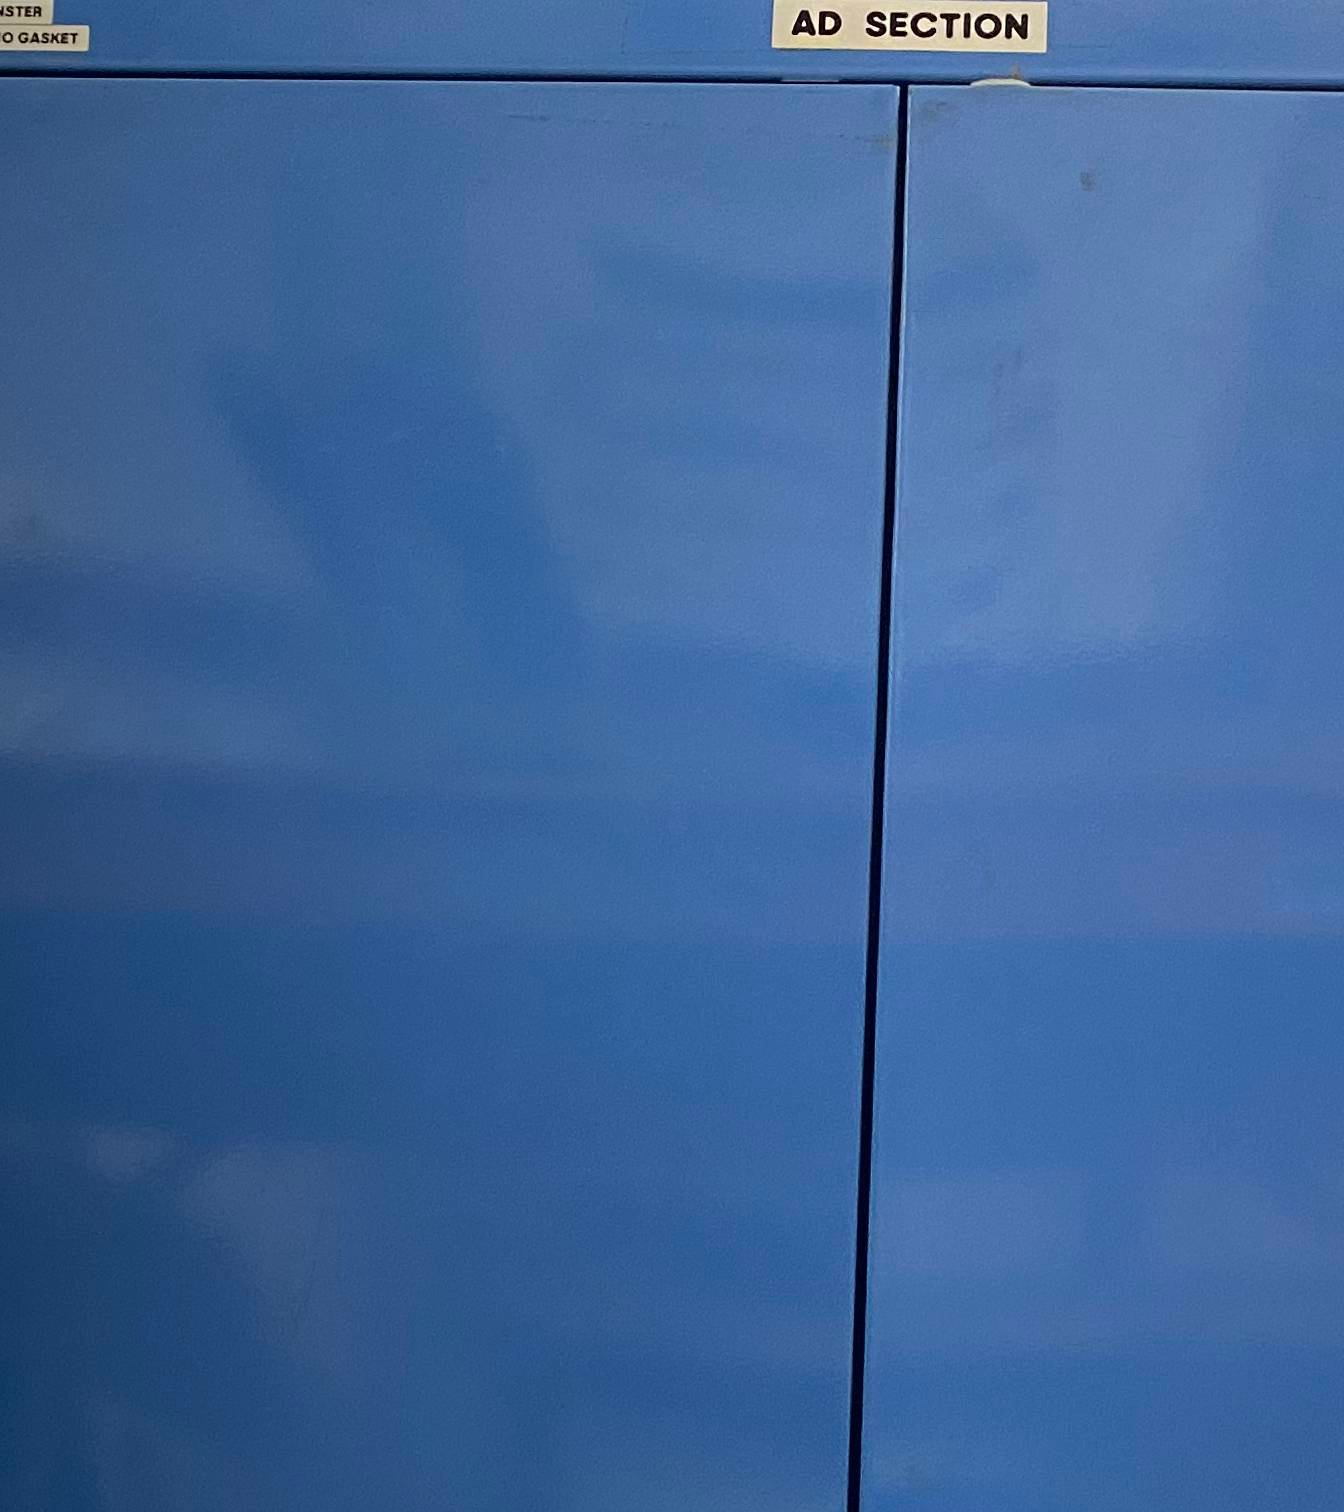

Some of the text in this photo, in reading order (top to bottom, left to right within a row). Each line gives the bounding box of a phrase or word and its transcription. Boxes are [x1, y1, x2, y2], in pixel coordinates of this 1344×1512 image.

[791, 9, 1029, 40] AD SECTION
[18, 32, 78, 44] GASKET
